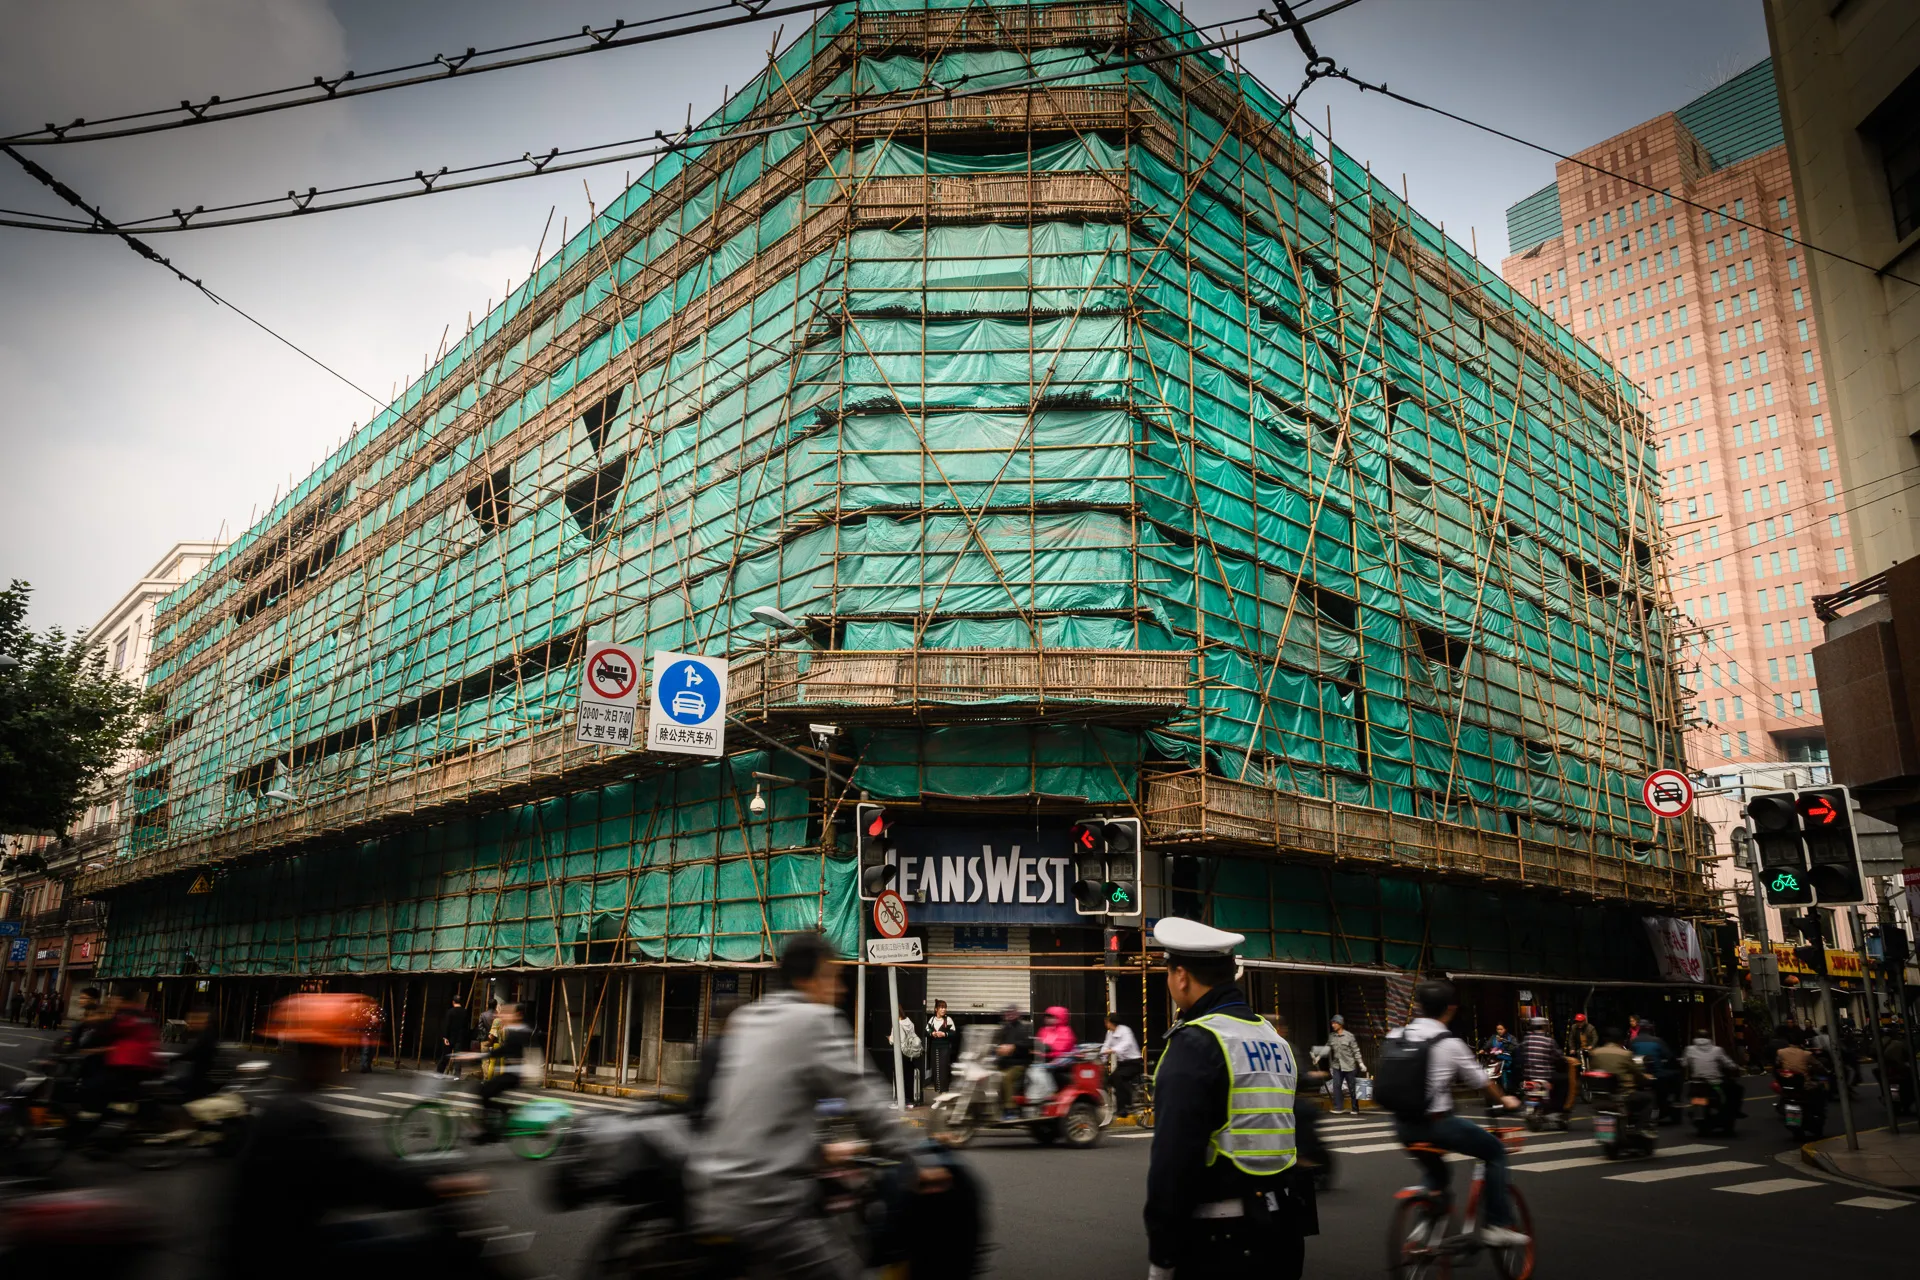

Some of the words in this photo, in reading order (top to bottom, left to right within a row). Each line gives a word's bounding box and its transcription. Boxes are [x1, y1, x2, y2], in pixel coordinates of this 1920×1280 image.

[581, 722, 629, 741] 大型号牌
[659, 727, 714, 746] 除公共汽车外
[1241, 1041, 1292, 1074] HPFJ
